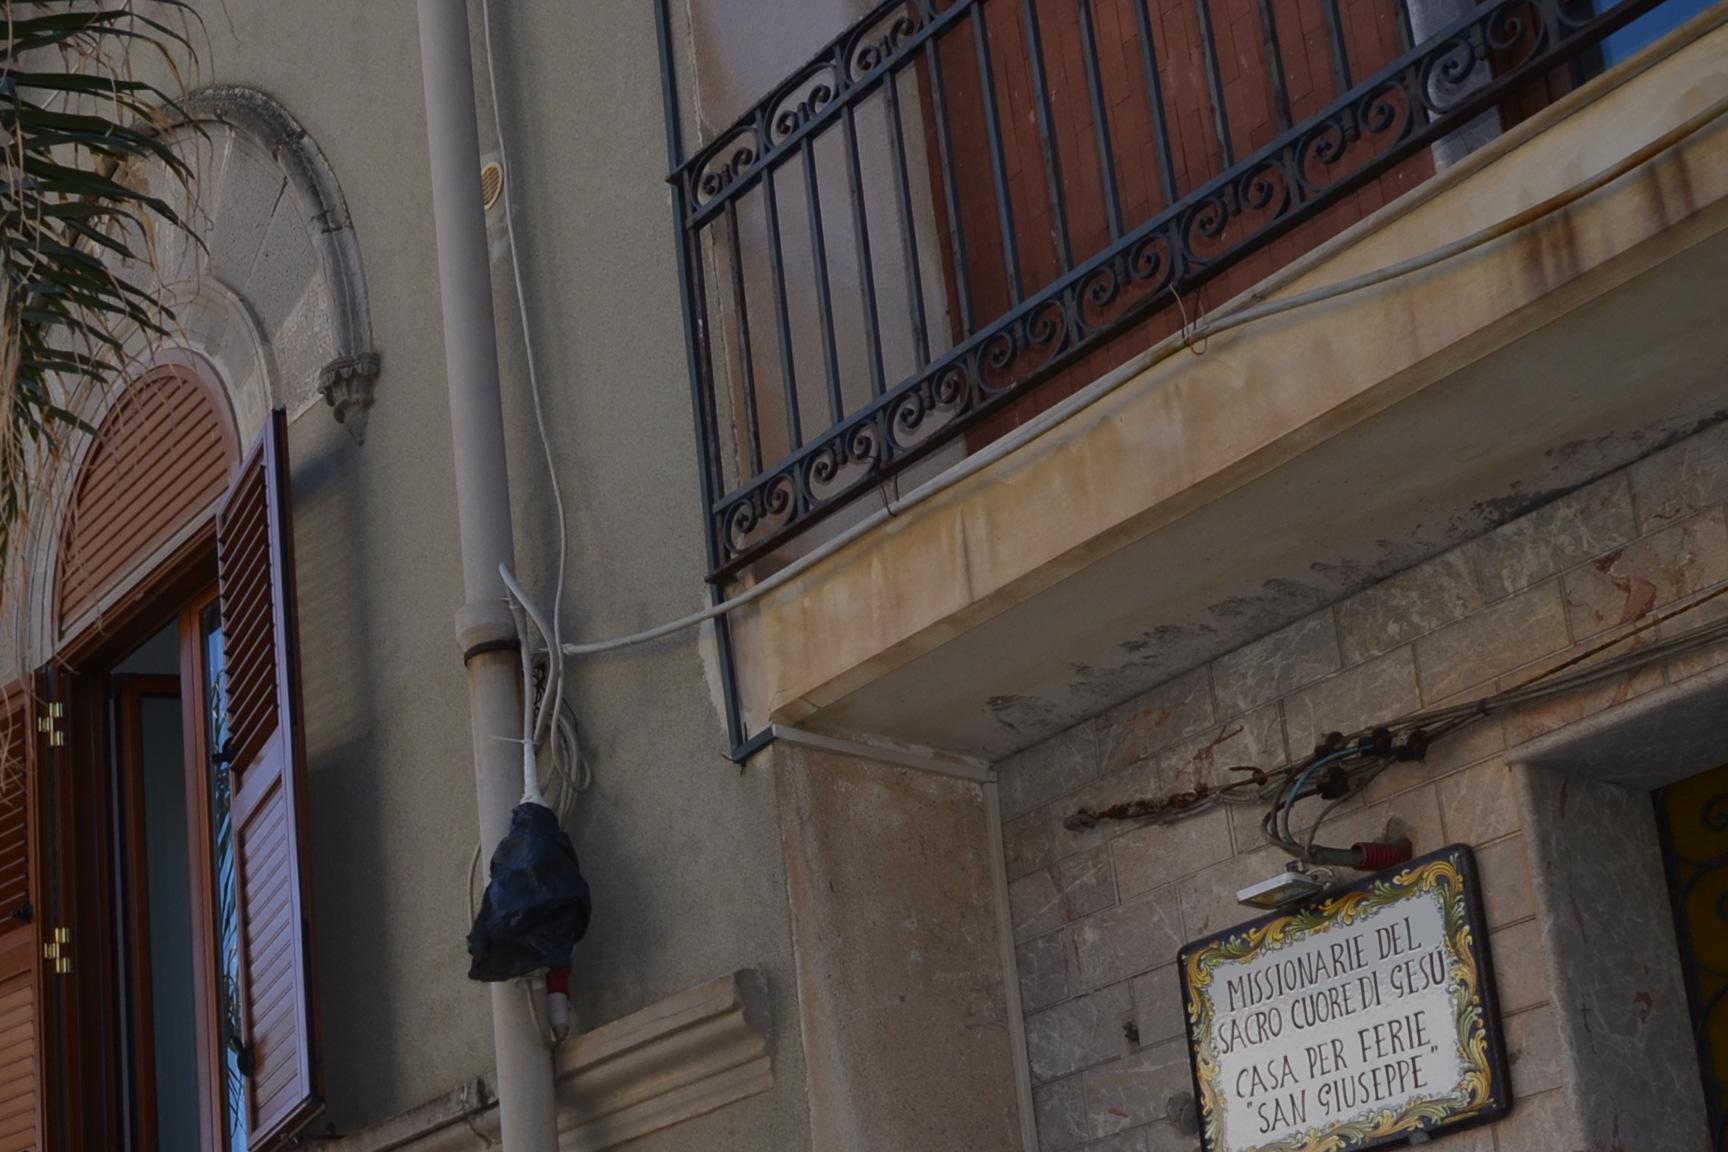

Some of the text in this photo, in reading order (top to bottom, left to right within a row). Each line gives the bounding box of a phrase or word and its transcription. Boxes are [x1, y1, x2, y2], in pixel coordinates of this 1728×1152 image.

[1227, 916, 1422, 1012] MISSIONARIE DEL
[1218, 1007, 1282, 1054] SACRO
[1291, 983, 1355, 1030] CUORE
[1358, 971, 1381, 1011] DI
[1236, 1011, 1431, 1099] CASA PER FERIE
